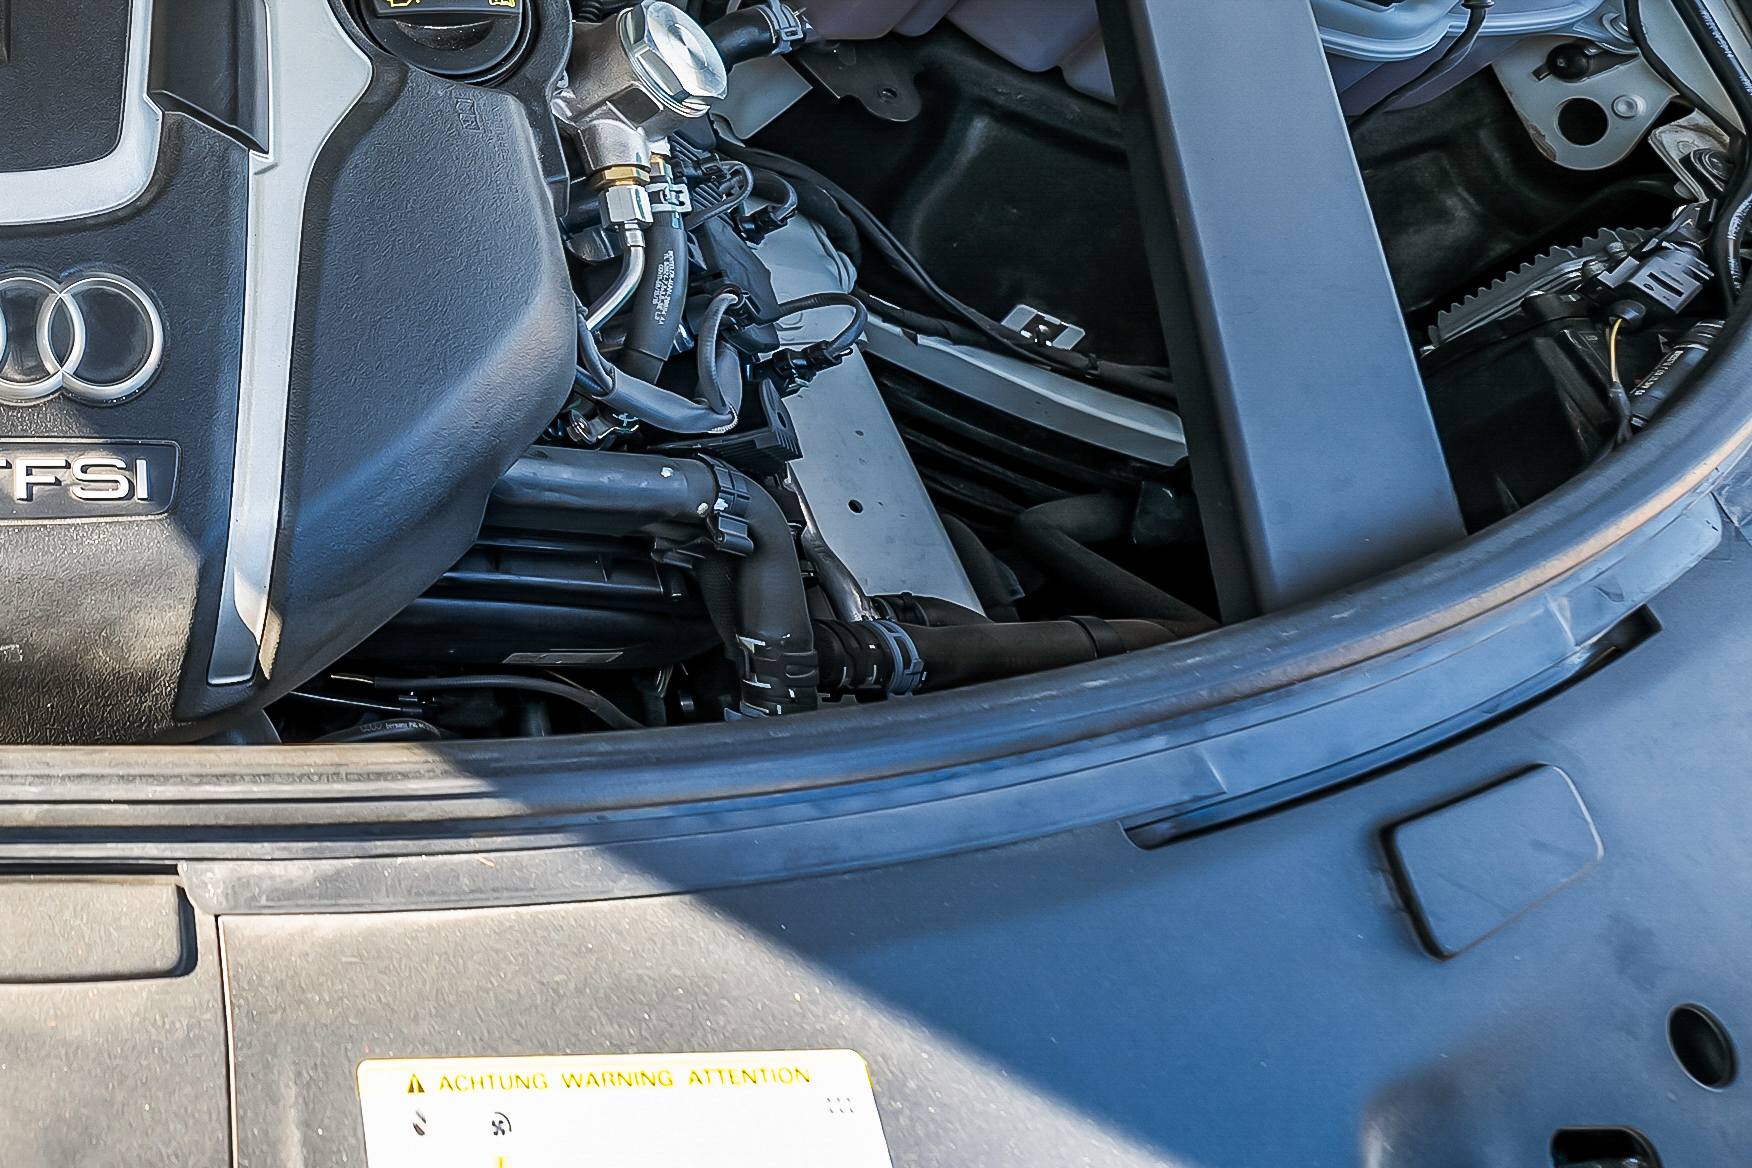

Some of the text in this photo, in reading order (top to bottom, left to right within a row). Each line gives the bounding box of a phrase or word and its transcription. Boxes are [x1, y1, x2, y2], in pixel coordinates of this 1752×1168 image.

[439, 1066, 811, 1092] ACHTUNG WARNING ATTENTION
